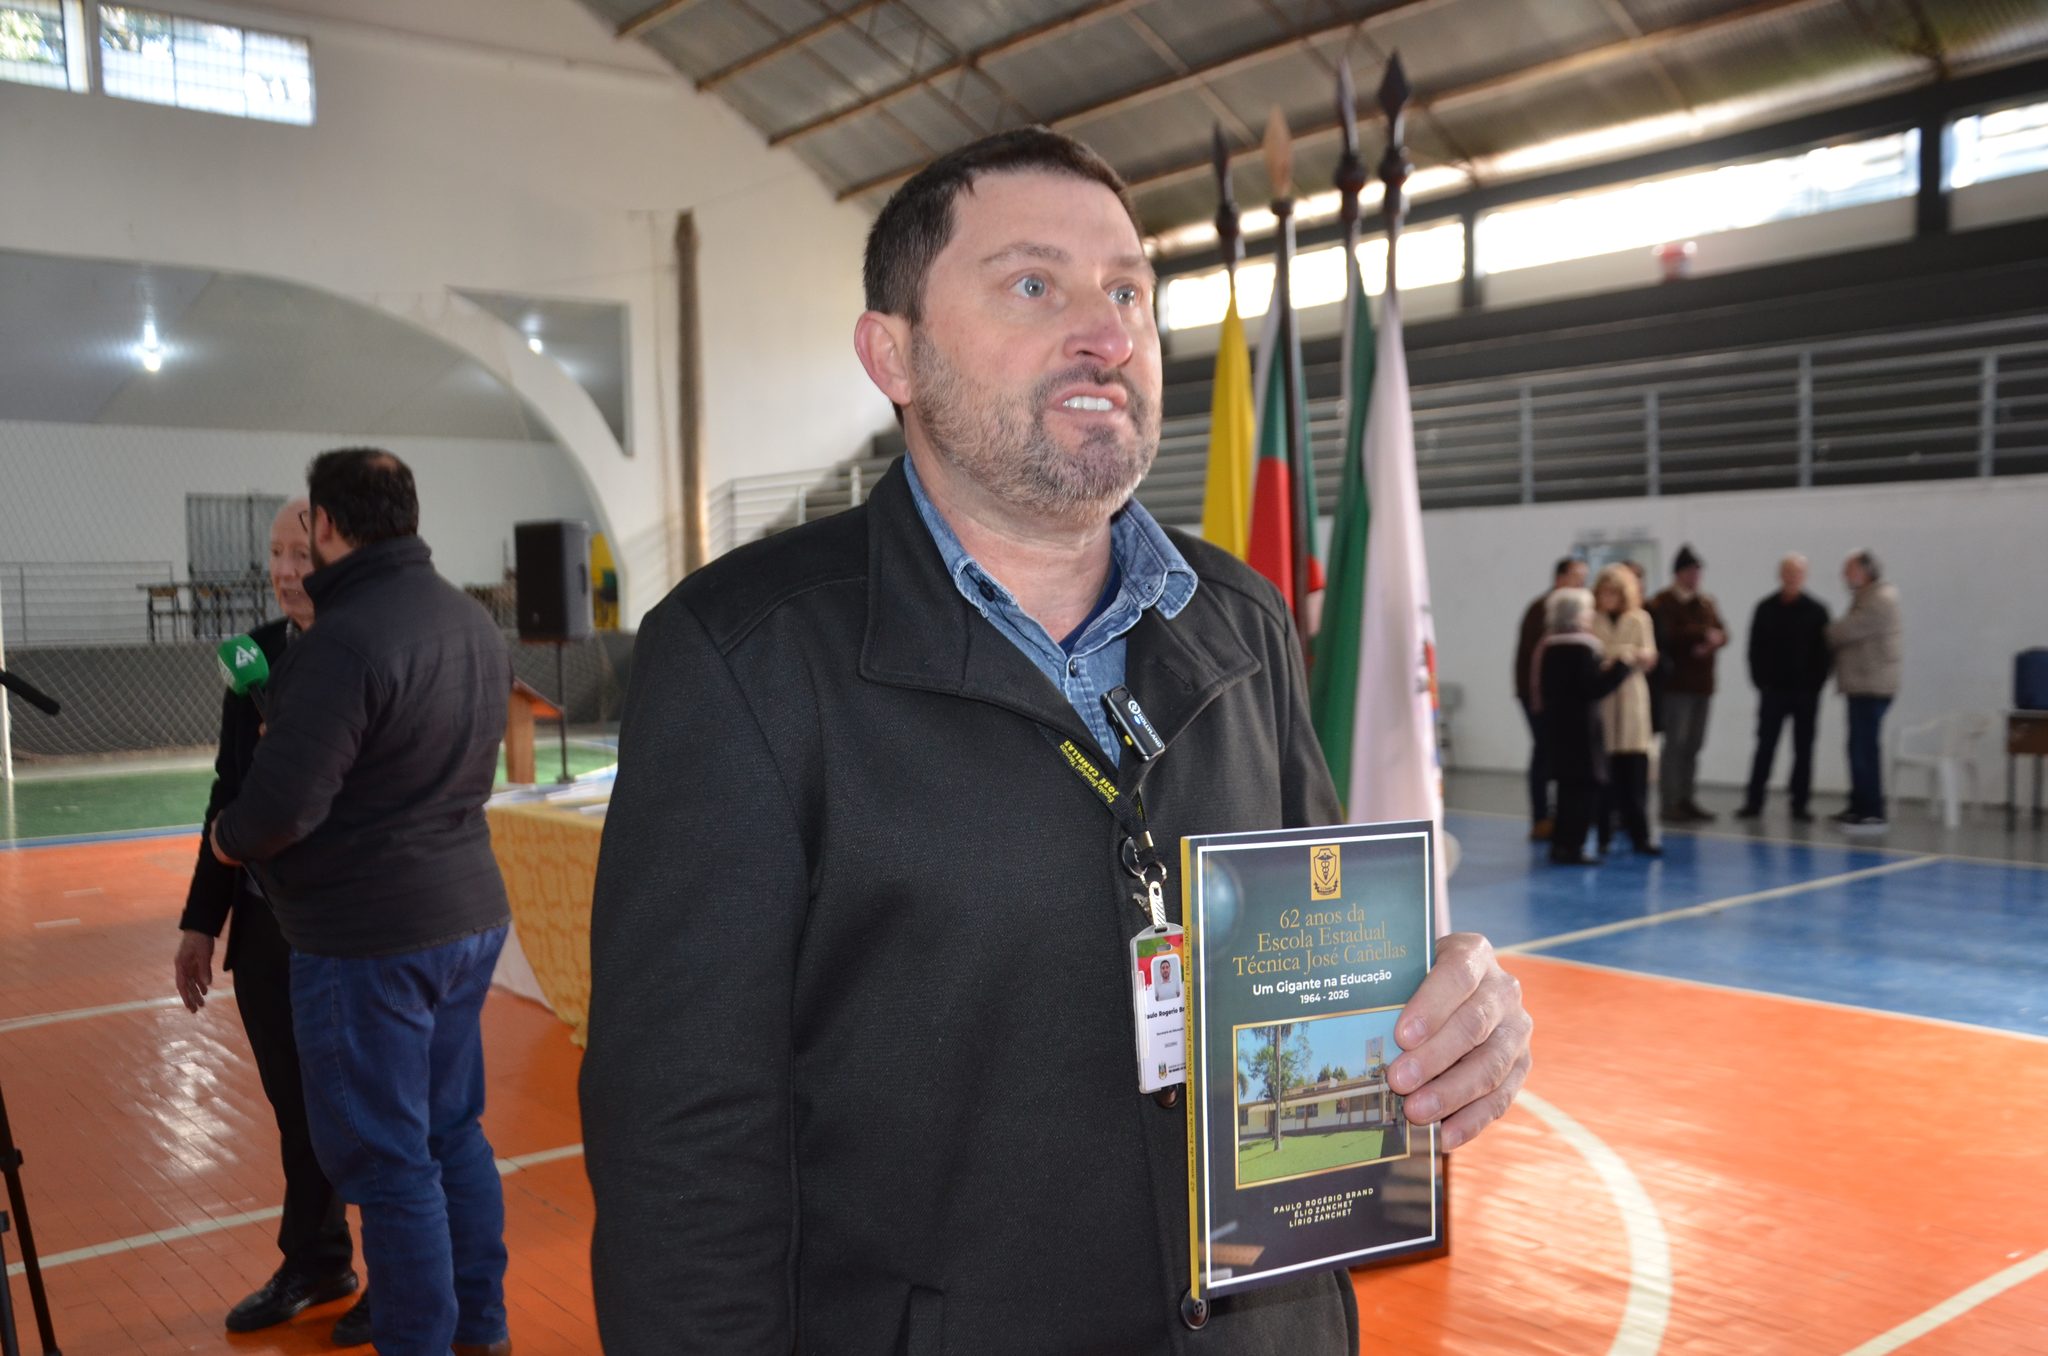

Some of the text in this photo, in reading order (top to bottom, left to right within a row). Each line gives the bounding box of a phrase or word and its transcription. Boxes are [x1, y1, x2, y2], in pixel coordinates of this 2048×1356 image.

[1138, 711, 1162, 748] HOLLYLAND
[1096, 785, 1115, 804] Escola
[1280, 903, 1365, 929] 62 anos da
[1257, 921, 1386, 952] Escola Estadual
[1233, 941, 1407, 976] Técnica José Cañellas
[1253, 970, 1392, 996] Um Gigante na Educação
[1300, 993, 1321, 1004] 1964
[1329, 989, 1350, 1001] 2026
[1273, 1187, 1374, 1215] PAULO ROGÉRIO BRAND
[1294, 1200, 1353, 1219] ÉLIO ZANCHET
[1289, 1209, 1352, 1228] LÍRIO ZANCHET
